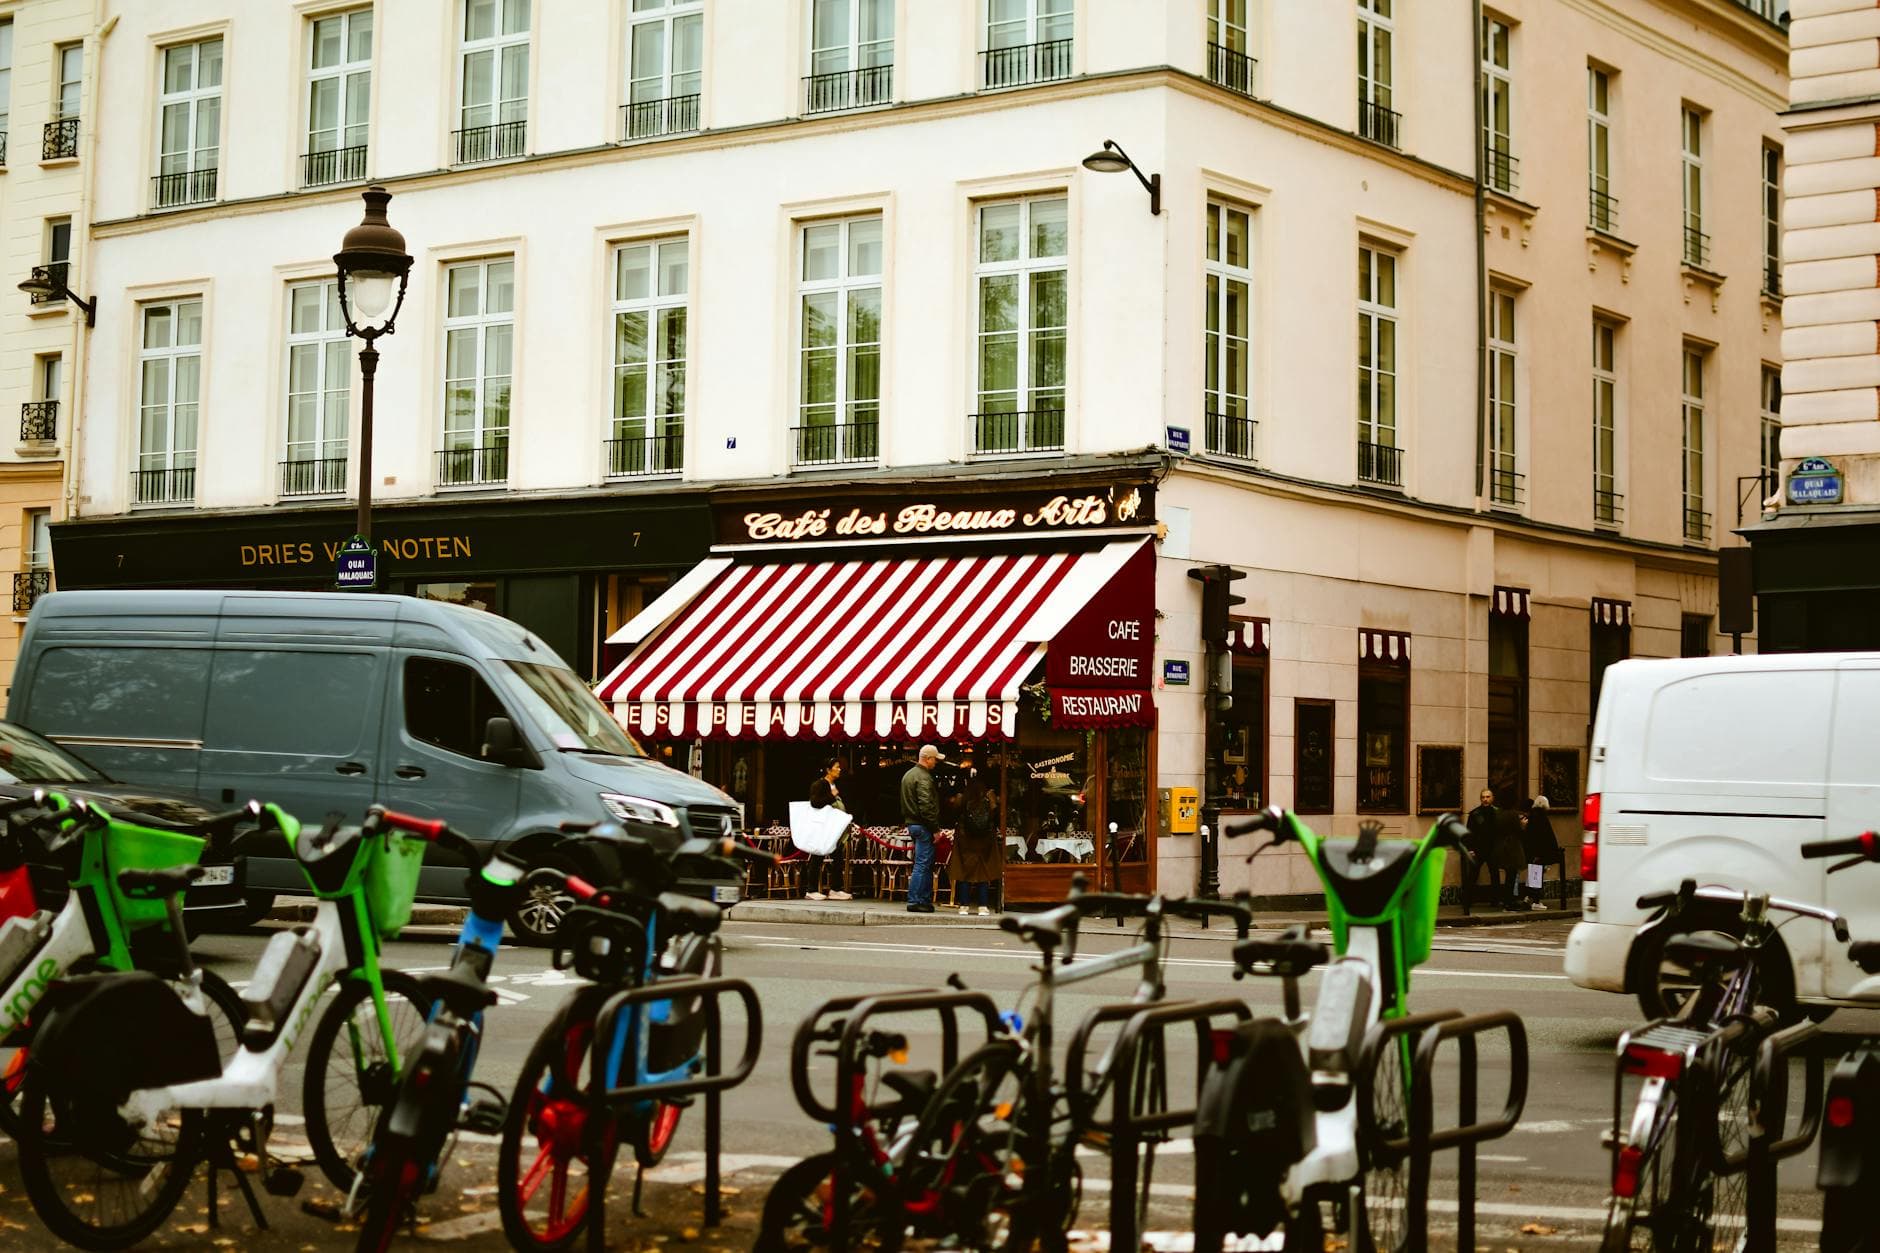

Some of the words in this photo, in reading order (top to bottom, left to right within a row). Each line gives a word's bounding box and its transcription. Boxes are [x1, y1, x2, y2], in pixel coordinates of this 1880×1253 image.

[1804, 479, 1824, 489] QUAI
[1792, 488, 1837, 498] MALAQUAIS
[744, 509, 831, 541] Café
[836, 508, 887, 536] des
[894, 504, 1015, 534] Beaux
[1024, 495, 1106, 528] Arts
[633, 532, 641, 548] 7
[240, 543, 314, 565] DRIES
[383, 536, 472, 560] NOTEN
[117, 554, 124, 568] 7
[348, 560, 365, 569] QUAI
[338, 570, 374, 581] MALAQUAIS
[1108, 619, 1140, 641] CAFÉ
[1070, 656, 1138, 678] BRASSERIE
[1061, 693, 1142, 716] RESTAURANT
[713, 704, 845, 726] BEAUX
[891, 704, 1001, 726] ARTS
[1033, 752, 1075, 769] GASTRONOMIE
